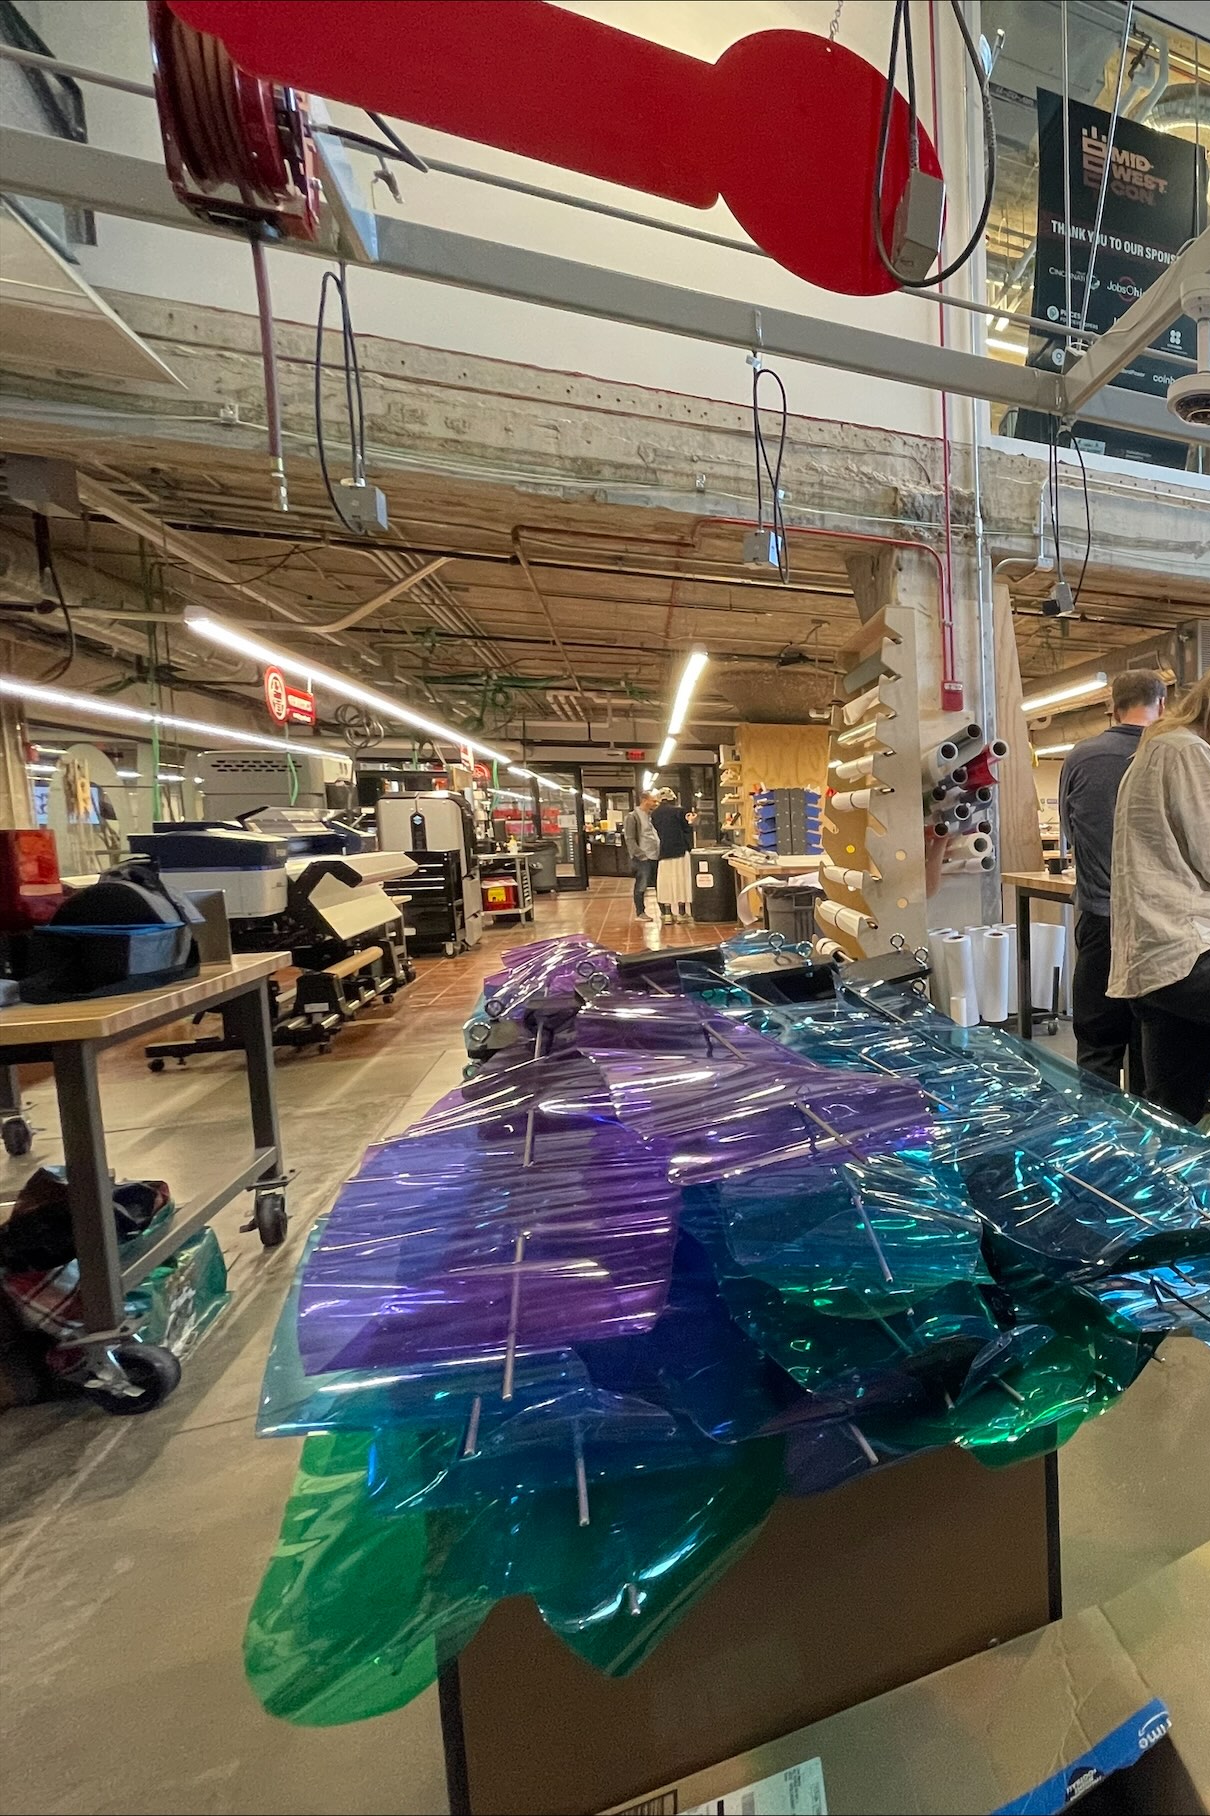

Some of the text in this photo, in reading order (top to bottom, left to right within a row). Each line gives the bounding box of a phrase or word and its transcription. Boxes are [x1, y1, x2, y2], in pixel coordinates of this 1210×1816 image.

[1111, 147, 1152, 172] MID
[1111, 163, 1168, 193] WEST
[1110, 180, 1154, 206] CON
[1109, 236, 1122, 251] TO
[1123, 240, 1144, 257] OUR
[1145, 246, 1177, 265] SPONS
[1049, 266, 1086, 282] CINCNATI
[1107, 280, 1146, 298] JobsOhi
